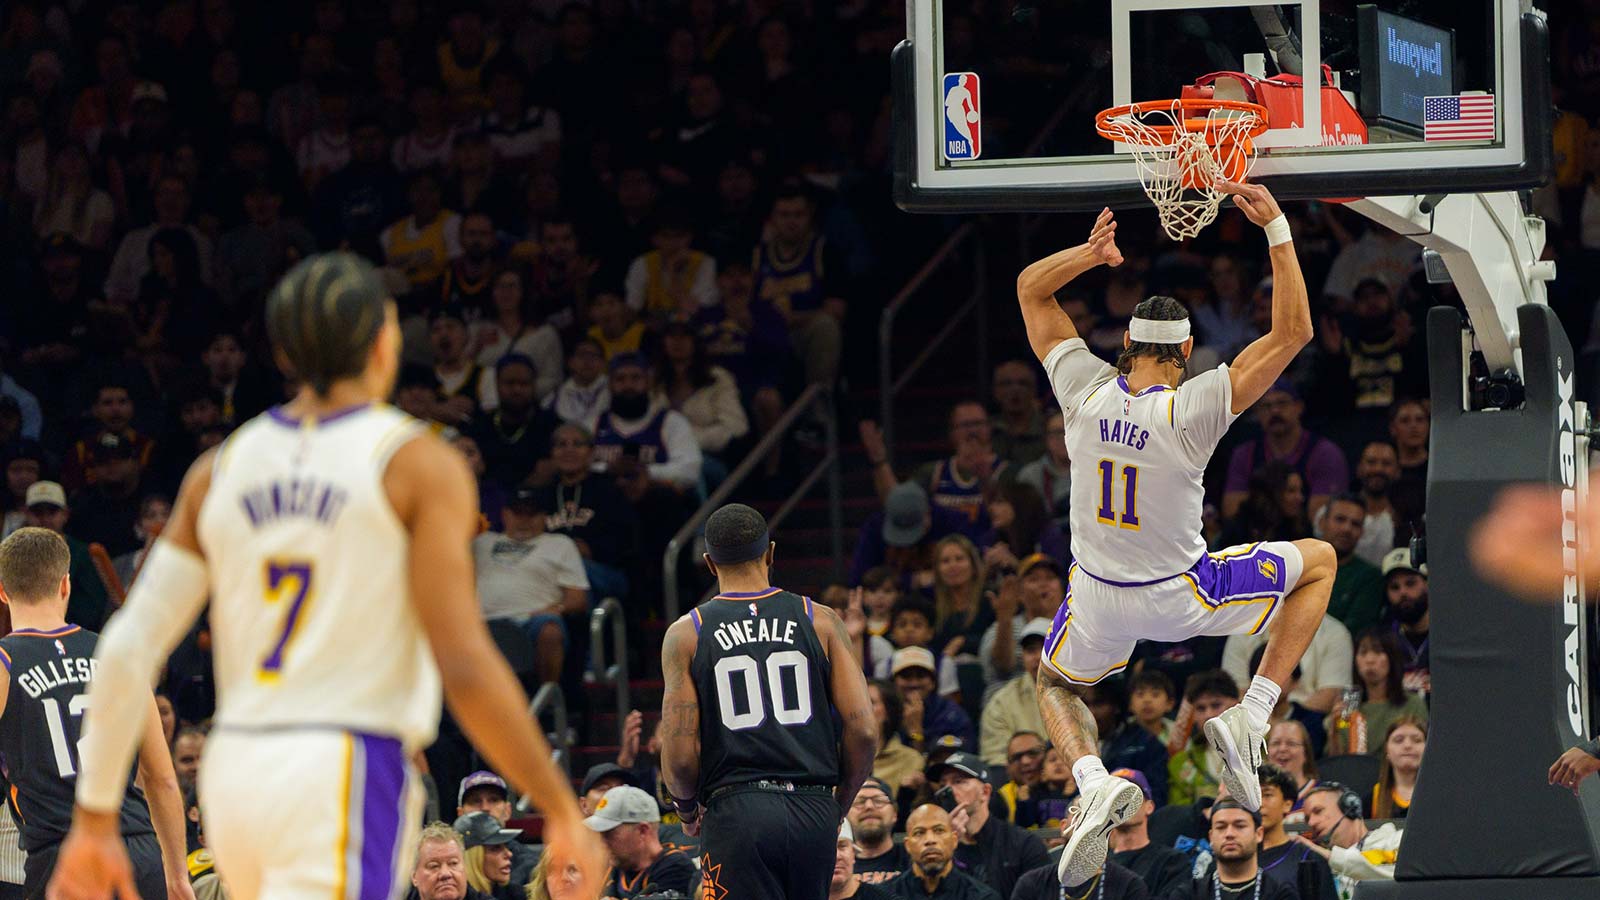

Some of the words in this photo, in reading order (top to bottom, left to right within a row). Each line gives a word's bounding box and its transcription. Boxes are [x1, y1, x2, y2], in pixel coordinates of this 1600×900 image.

[1387, 26, 1443, 78] Honeywell
[948, 140, 967, 155] NBA
[1099, 418, 1150, 451] HAYES
[1097, 457, 1142, 532] 11
[256, 555, 317, 683] 7
[713, 617, 798, 651] O'NEALE
[713, 649, 813, 732] 00
